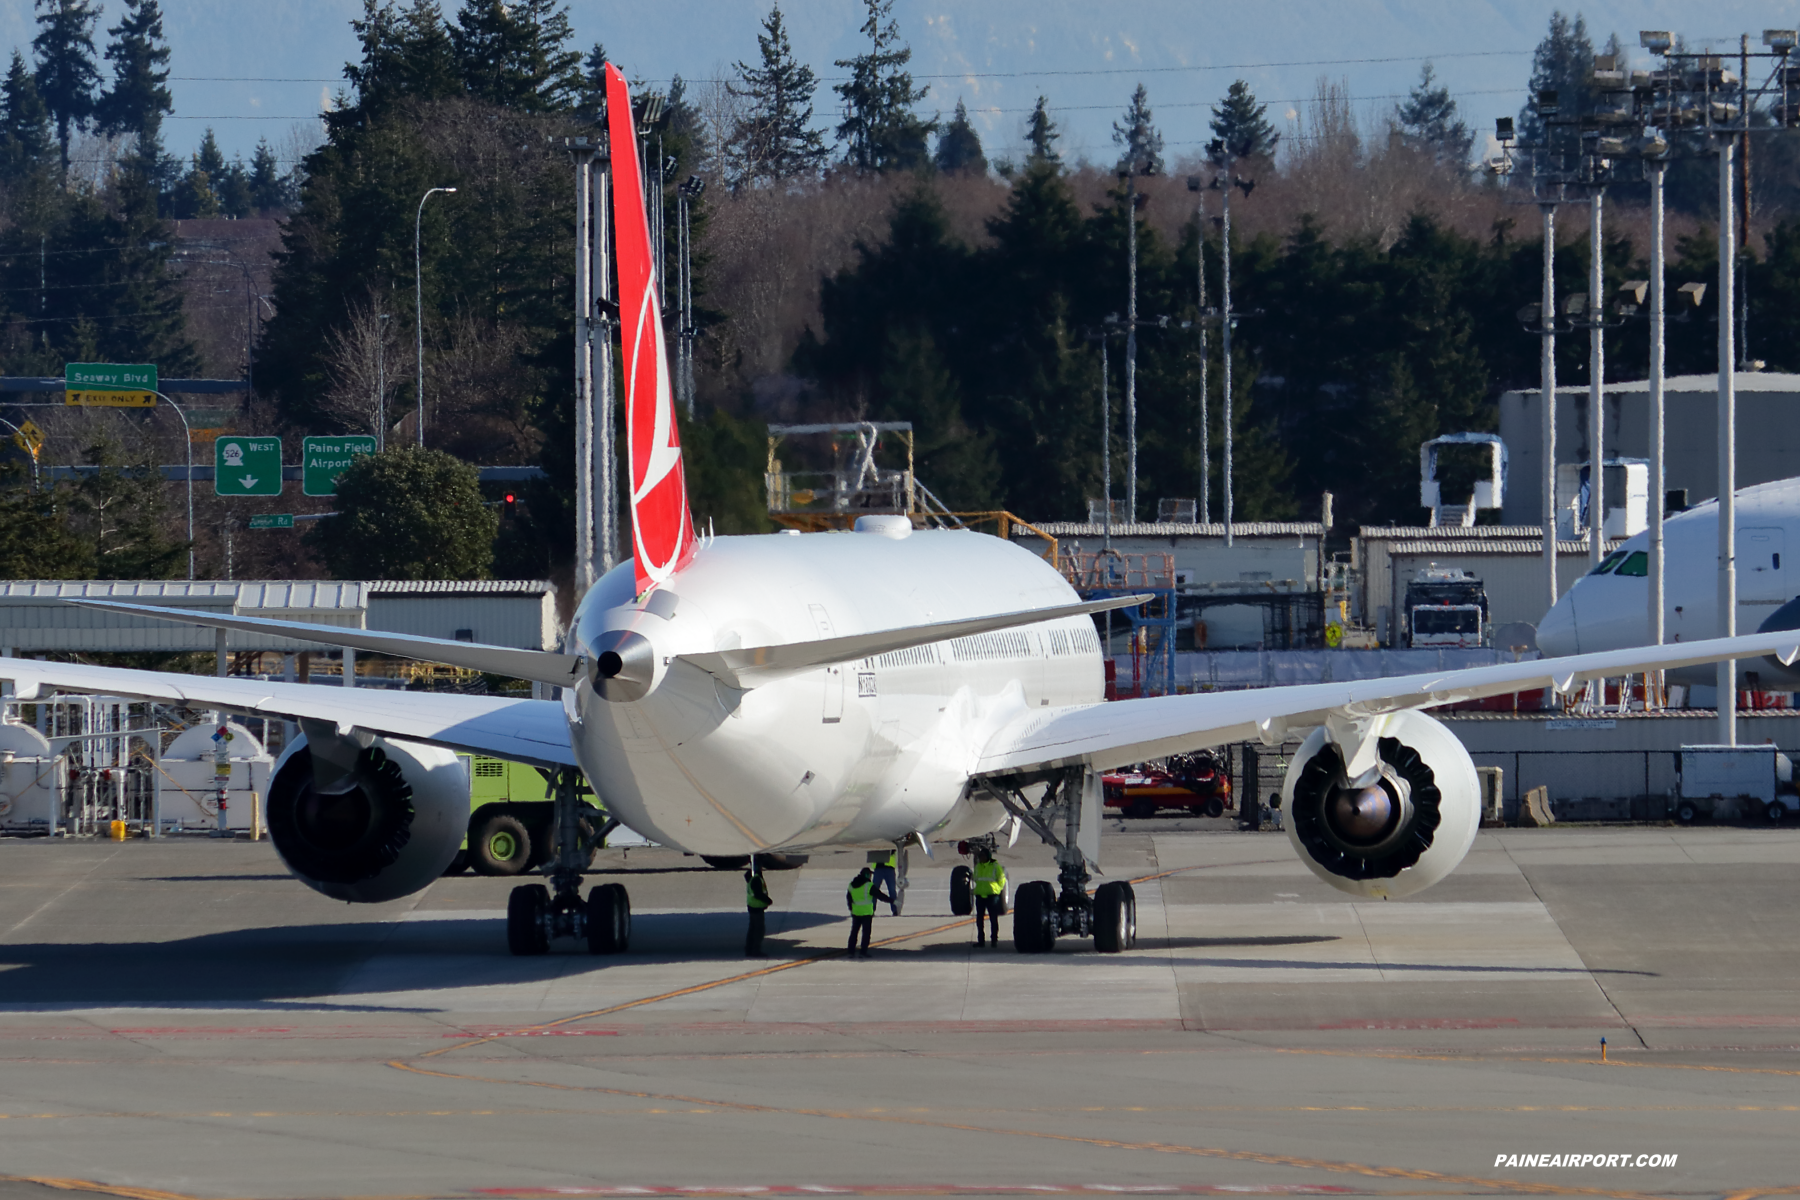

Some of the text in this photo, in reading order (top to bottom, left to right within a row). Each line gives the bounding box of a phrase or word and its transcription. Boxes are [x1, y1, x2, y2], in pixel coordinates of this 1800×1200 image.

[74, 372, 148, 384] Seaway Blvd
[85, 394, 106, 402] EXIT
[249, 442, 275, 452] WEST
[308, 442, 373, 453] Paine Field
[225, 449, 240, 458] 526
[309, 458, 353, 470] Airport
[277, 516, 288, 525] Rd
